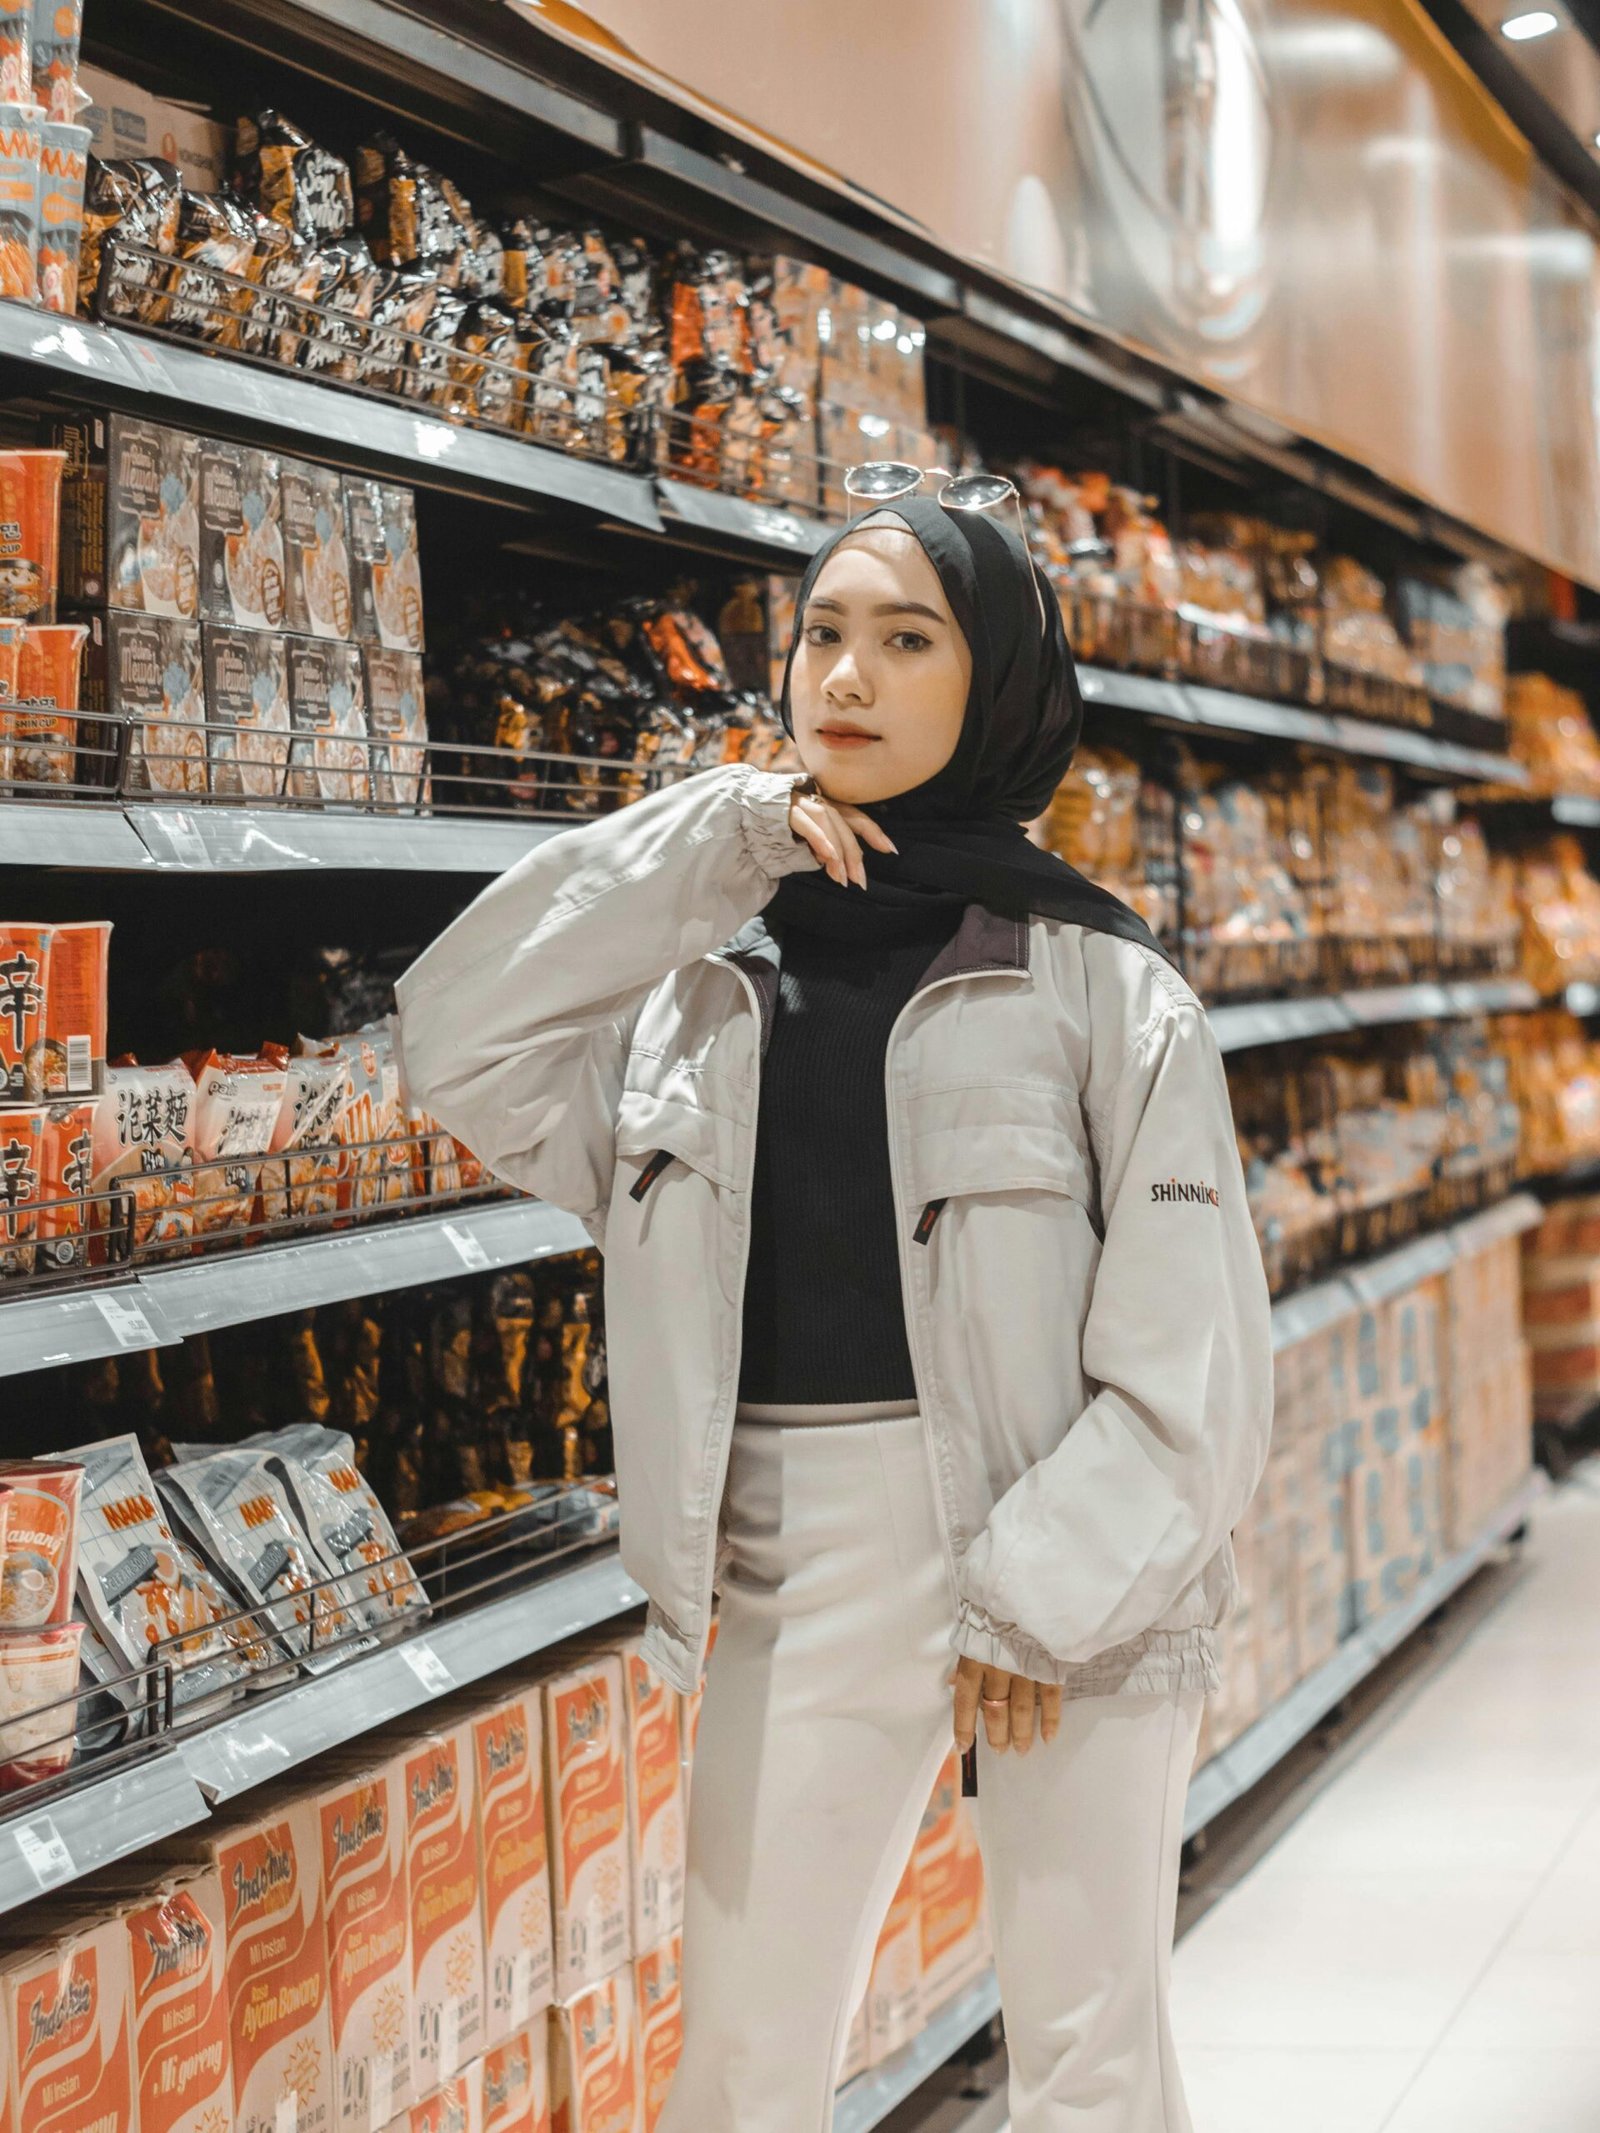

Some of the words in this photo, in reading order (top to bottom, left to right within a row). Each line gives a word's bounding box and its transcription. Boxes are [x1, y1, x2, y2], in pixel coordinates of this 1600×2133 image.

[15, 719, 37, 728] SHIN
[39, 718, 57, 727] CUP
[0, 951, 44, 1053] 辛
[113, 1089, 189, 1146] 泡菜麵
[0, 1138, 38, 1240] 辛
[108, 1563, 136, 1590] CLEAR
[329, 1806, 383, 1881] Indomie
[228, 1848, 292, 1931] Indomie
[261, 1936, 286, 1960] Instan
[173, 2004, 195, 2029] Instan
[242, 1996, 277, 2042] Ayam
[279, 1973, 320, 2019] Bawang
[54, 2074, 80, 2102] Instan
[162, 2054, 178, 2094] Mi
[177, 2040, 223, 2095] goreng
